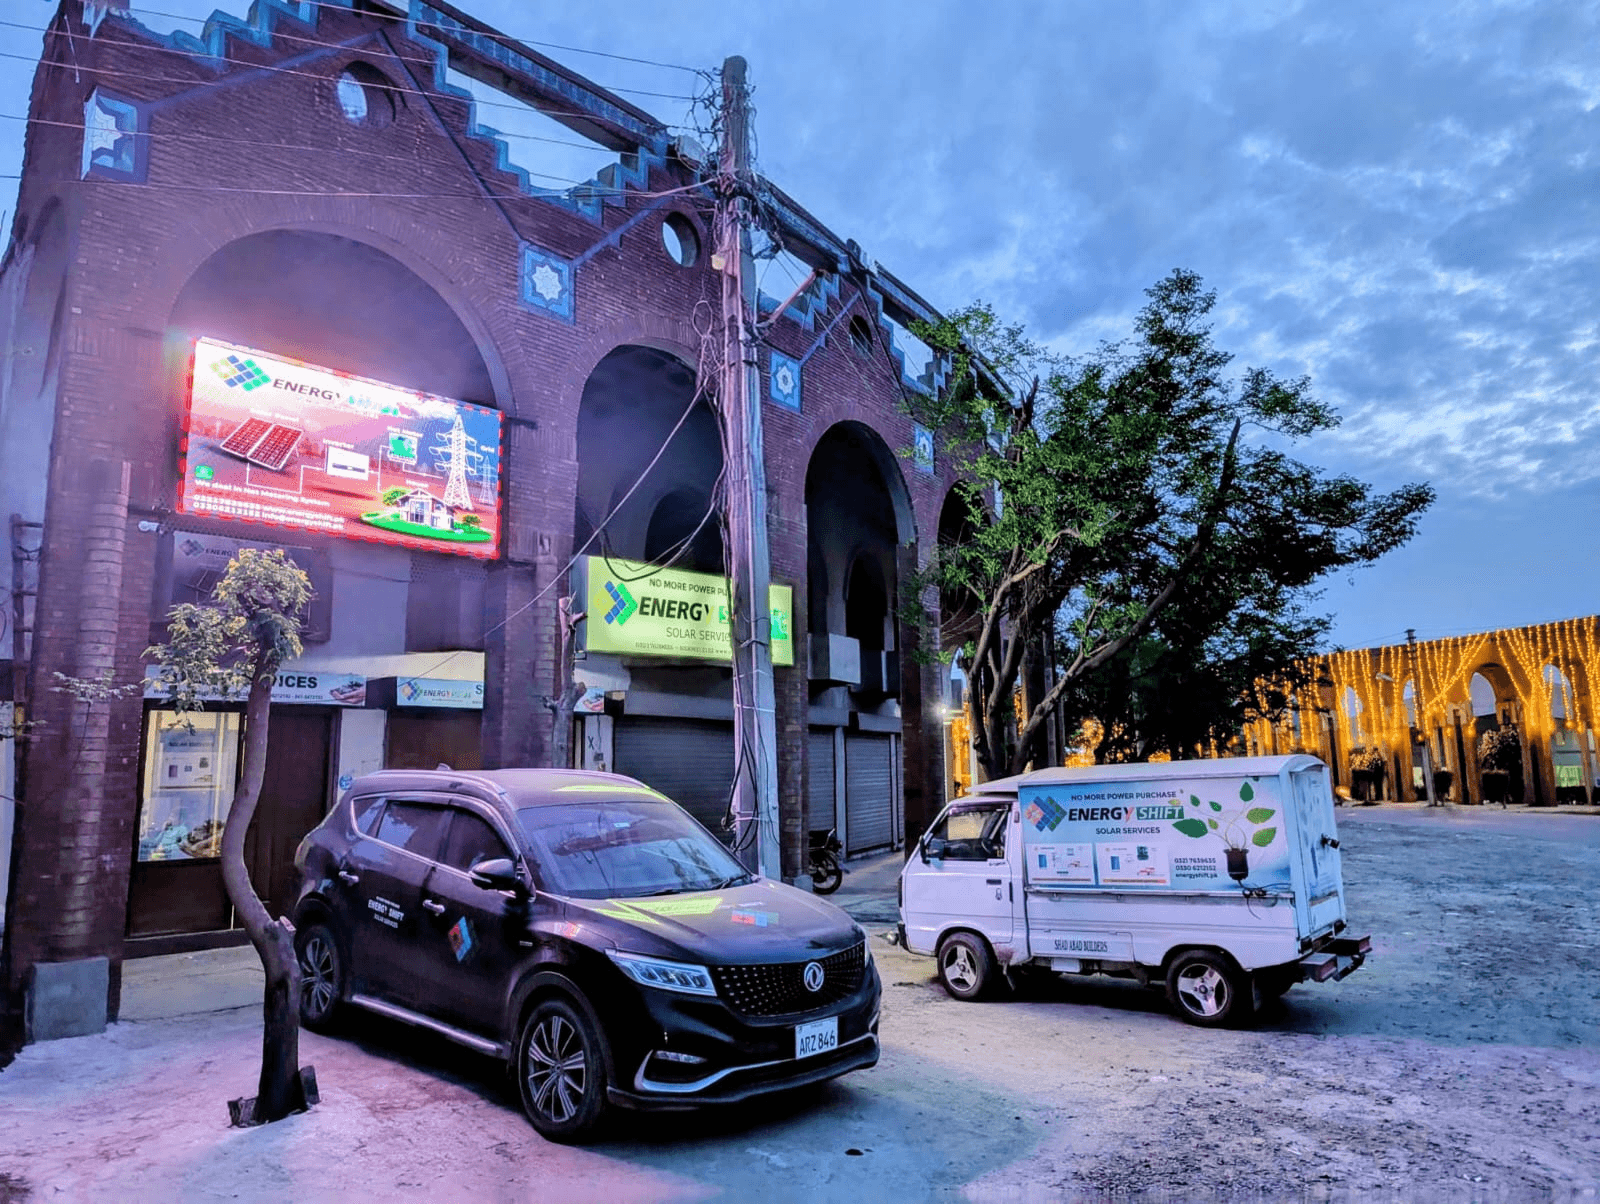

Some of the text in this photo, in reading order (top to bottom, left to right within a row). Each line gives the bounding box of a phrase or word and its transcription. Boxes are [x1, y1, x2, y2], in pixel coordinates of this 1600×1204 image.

[649, 578, 662, 588] NO
[663, 581, 687, 591] MORE
[688, 583, 716, 595] POWER
[665, 626, 697, 639] SOLAR
[1107, 792, 1134, 800] POWER
[1135, 791, 1177, 799] PURCHASE
[1068, 806, 1184, 823] ENERGY SHIFT
[1096, 826, 1161, 835] SOLAR SERVICES
[799, 1029, 836, 1055] ARZ 846
